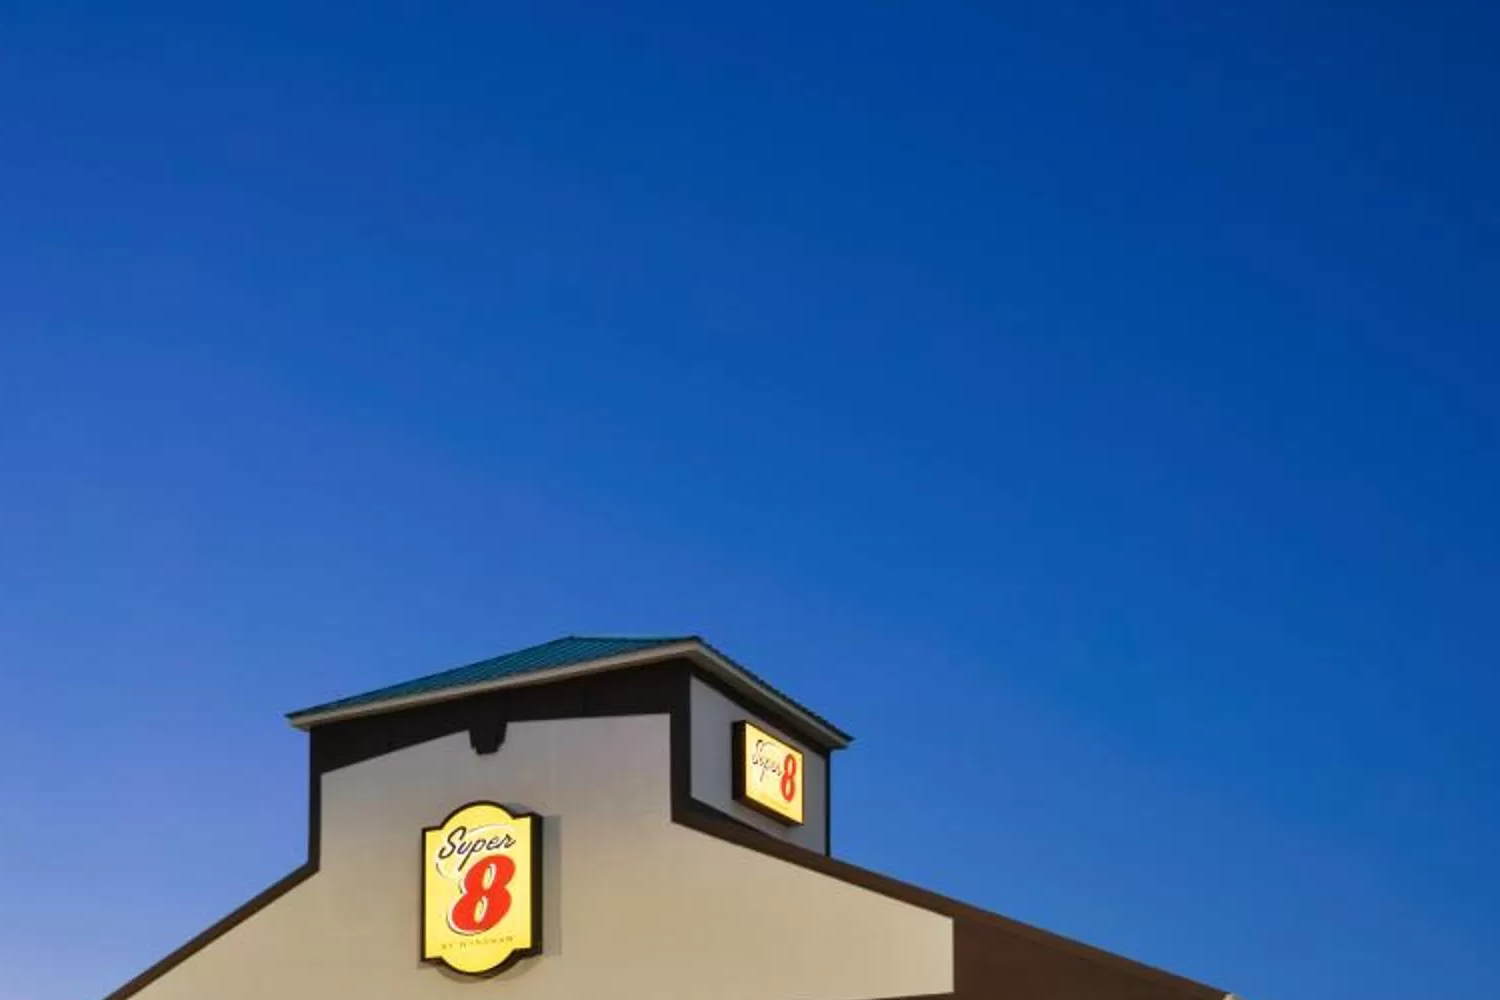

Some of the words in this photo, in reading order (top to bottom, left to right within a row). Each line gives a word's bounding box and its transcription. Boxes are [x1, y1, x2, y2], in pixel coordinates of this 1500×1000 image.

[780, 754, 797, 802] 8
[438, 826, 516, 872] Super
[448, 854, 517, 936] 8
